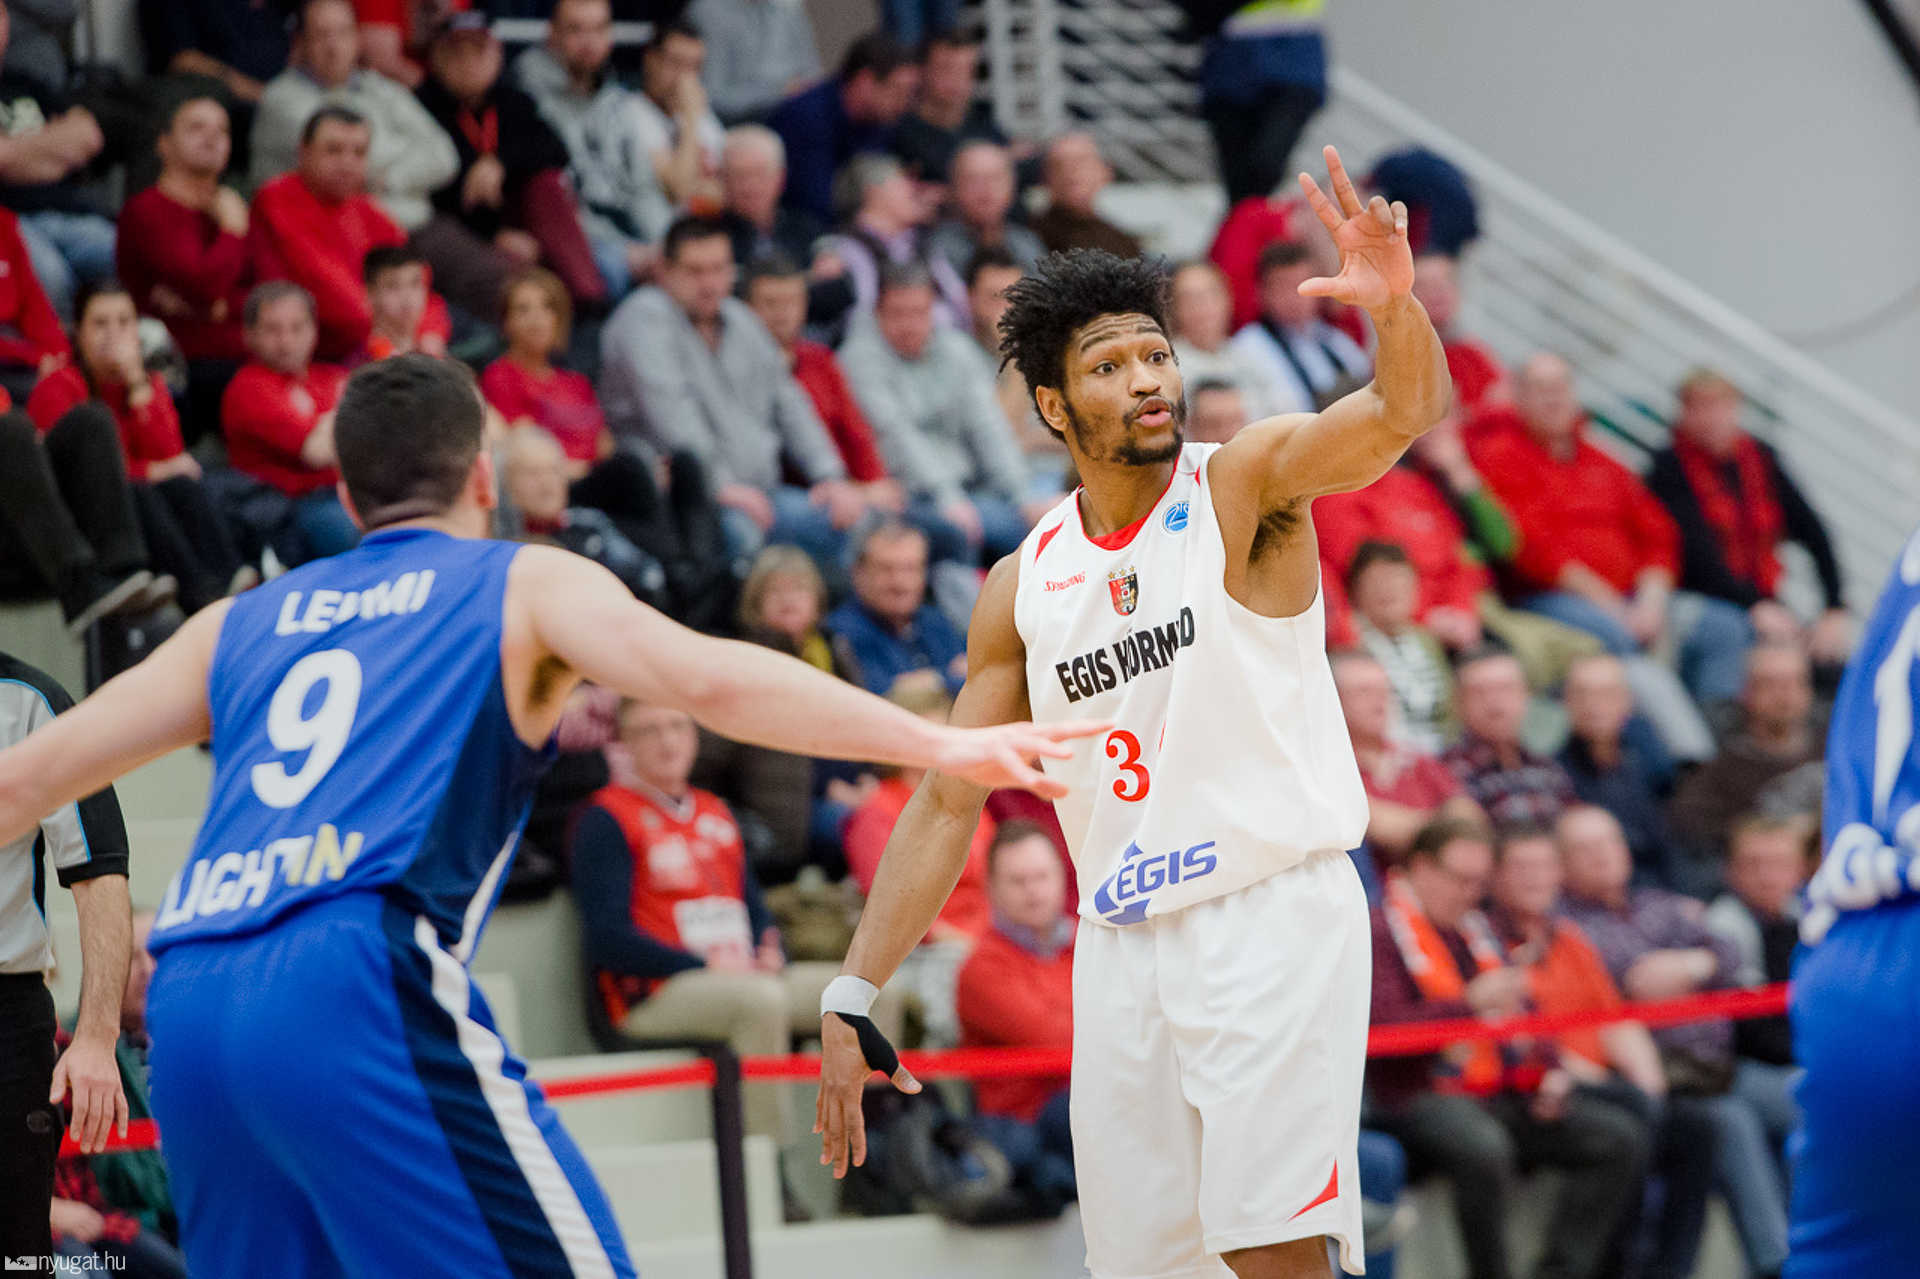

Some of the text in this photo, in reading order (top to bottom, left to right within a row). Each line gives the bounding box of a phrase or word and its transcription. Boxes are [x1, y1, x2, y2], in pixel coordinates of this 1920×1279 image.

[1056, 648, 1117, 704] EGIS
[250, 648, 363, 810] 9
[1116, 840, 1218, 901] EGIS
